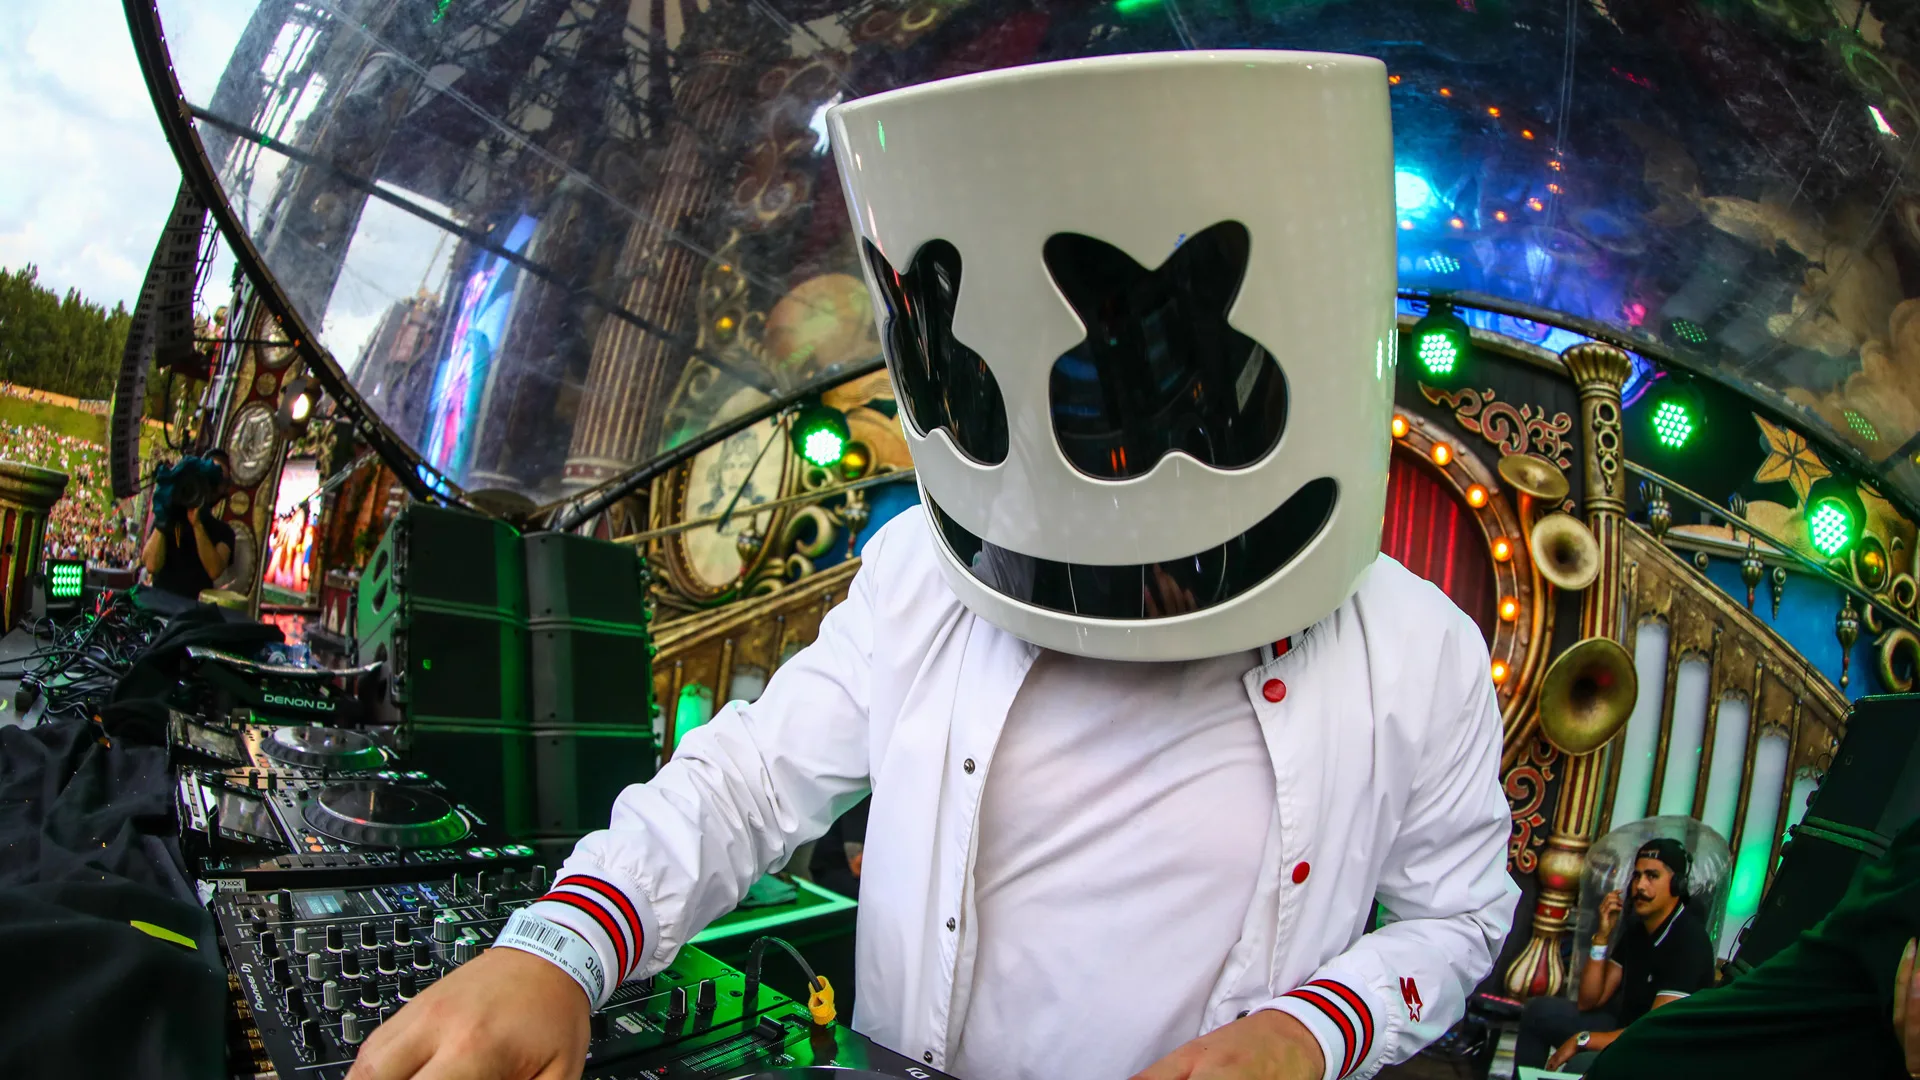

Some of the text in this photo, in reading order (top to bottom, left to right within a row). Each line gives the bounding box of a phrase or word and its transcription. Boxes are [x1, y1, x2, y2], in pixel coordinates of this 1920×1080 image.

[264, 694, 336, 711] DENON DJ
[514, 938, 558, 961] Tomorrowland
[246, 973, 268, 1012] Pioneer
[904, 1066, 931, 1080] DJ
